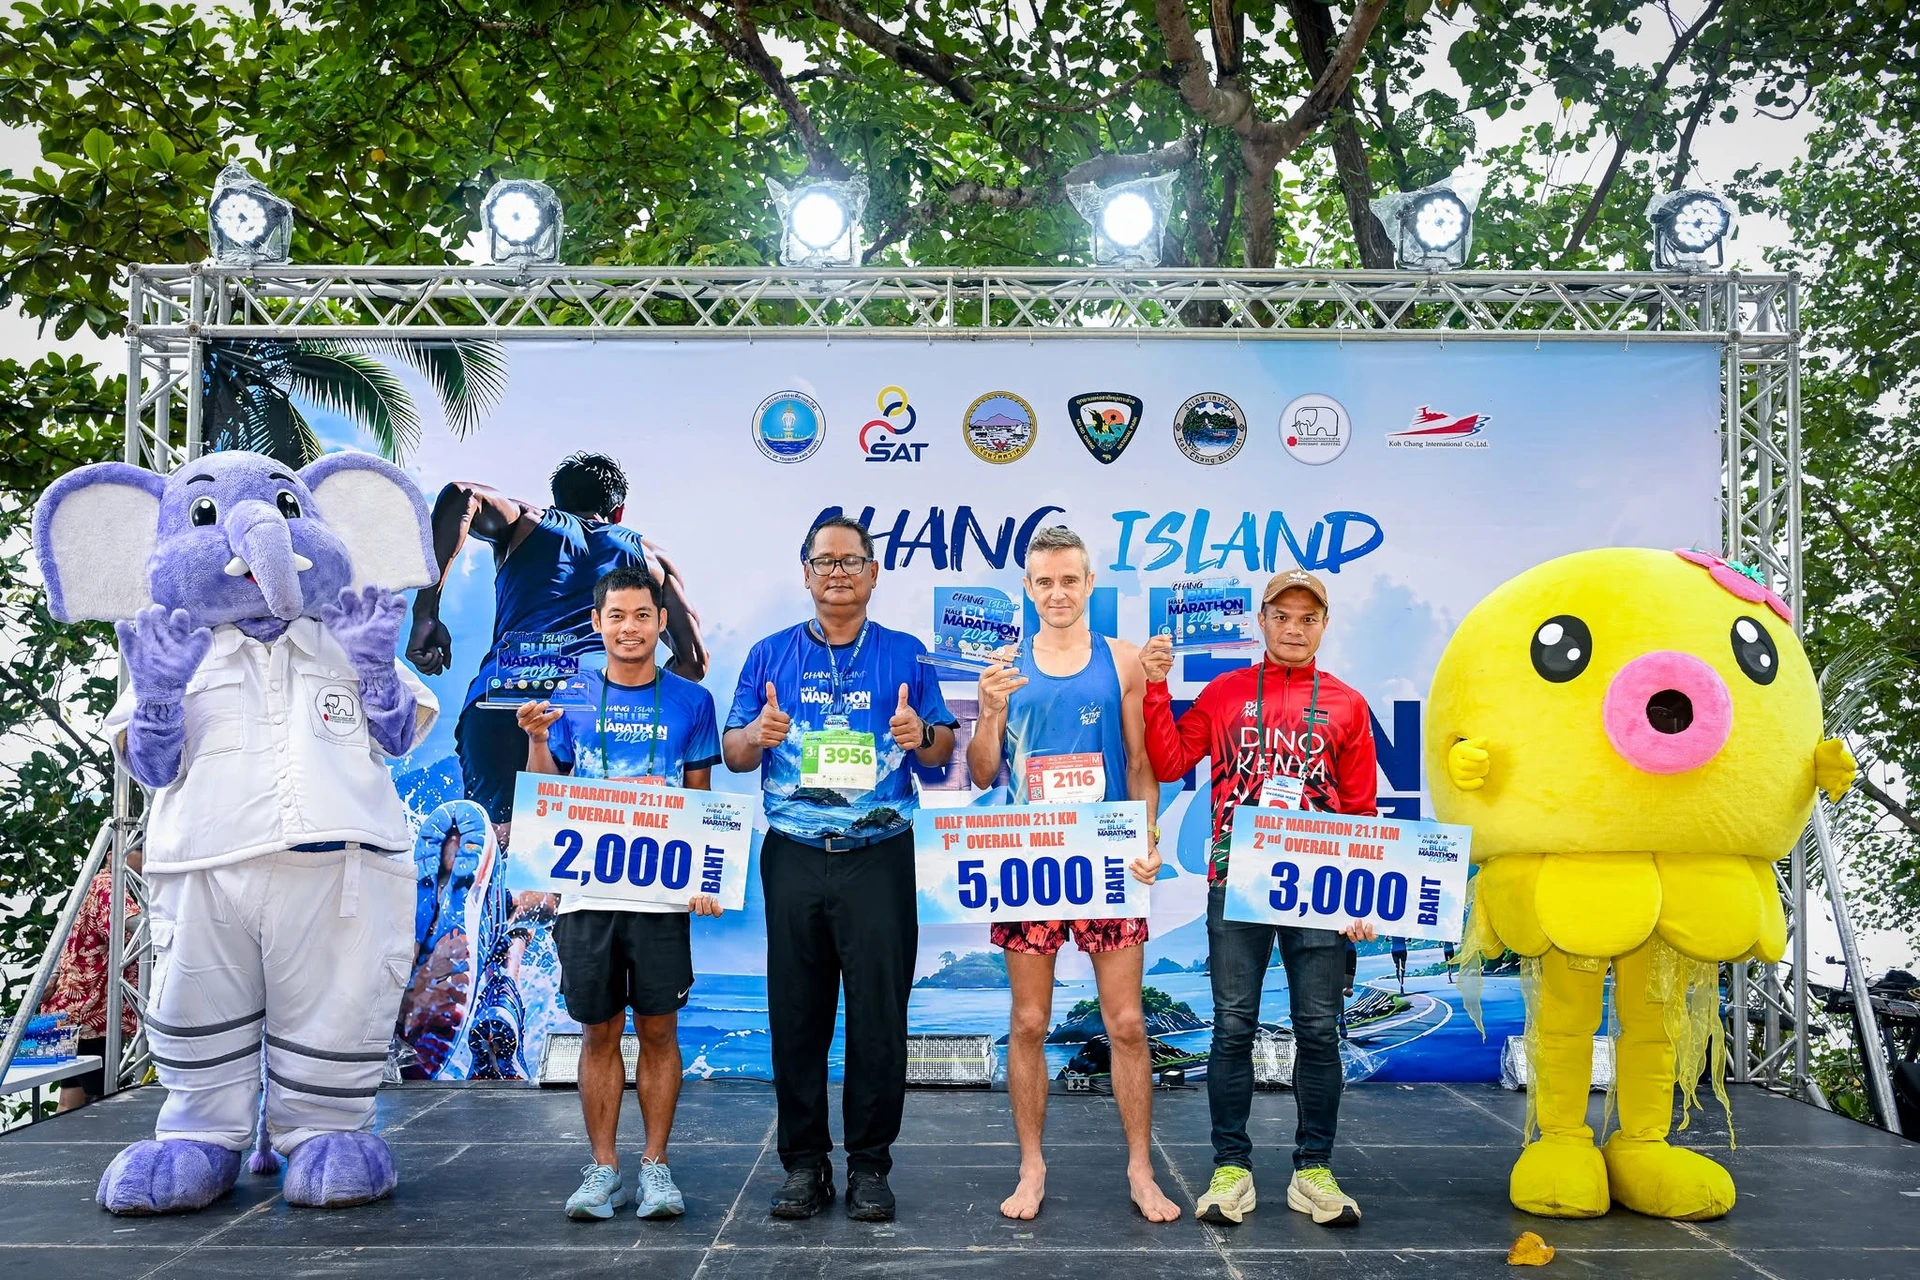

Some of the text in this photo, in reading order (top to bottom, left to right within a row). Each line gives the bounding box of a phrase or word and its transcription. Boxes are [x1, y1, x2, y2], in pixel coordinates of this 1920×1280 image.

[865, 443, 929, 462] SAT
[1178, 438, 1242, 463] Koh Chang District
[1108, 508, 1384, 574] ISLAND
[1172, 581, 1203, 592] CHANG
[1187, 589, 1224, 601] BLUE
[952, 592, 1020, 610] CHANG ISLAND
[1168, 599, 1243, 615] MARATHON
[945, 608, 963, 616] HALF
[964, 605, 1003, 622] BLUE
[943, 613, 1020, 637] MARATHON
[542, 634, 577, 643] ISLAND
[962, 628, 999, 643] 2026
[520, 643, 560, 655] BLUE
[500, 656, 579, 668] MARATHON
[520, 666, 558, 680] 2026
[1080, 712, 1100, 720] ACTIVE
[615, 732, 649, 744] 2026
[1240, 727, 1324, 754] DINO
[824, 747, 872, 765] 3956
[1236, 751, 1326, 782] KENYA
[1054, 770, 1095, 788] 2116
[537, 782, 685, 809] HALF MARATHON 21.1 KM
[568, 805, 625, 825] OVERALL
[633, 811, 669, 829] MALE
[702, 819, 741, 828] MARATHON
[934, 811, 1077, 830] HALF MARATHON 21.1 KM
[1254, 815, 1400, 840] HALF MARATHON 21.1 KM
[942, 832, 1065, 850] 1st OVERALL MALE
[1284, 837, 1340, 856] OVERALL
[1348, 843, 1384, 861] MALE
[550, 829, 692, 890] 2,000
[1418, 850, 1458, 859] MARATHON
[701, 845, 725, 894] BAHT
[958, 855, 1093, 913] 5,000
[1104, 856, 1125, 904] BAHT
[1268, 861, 1408, 921] 3,000
[1417, 876, 1441, 926] BAHT
